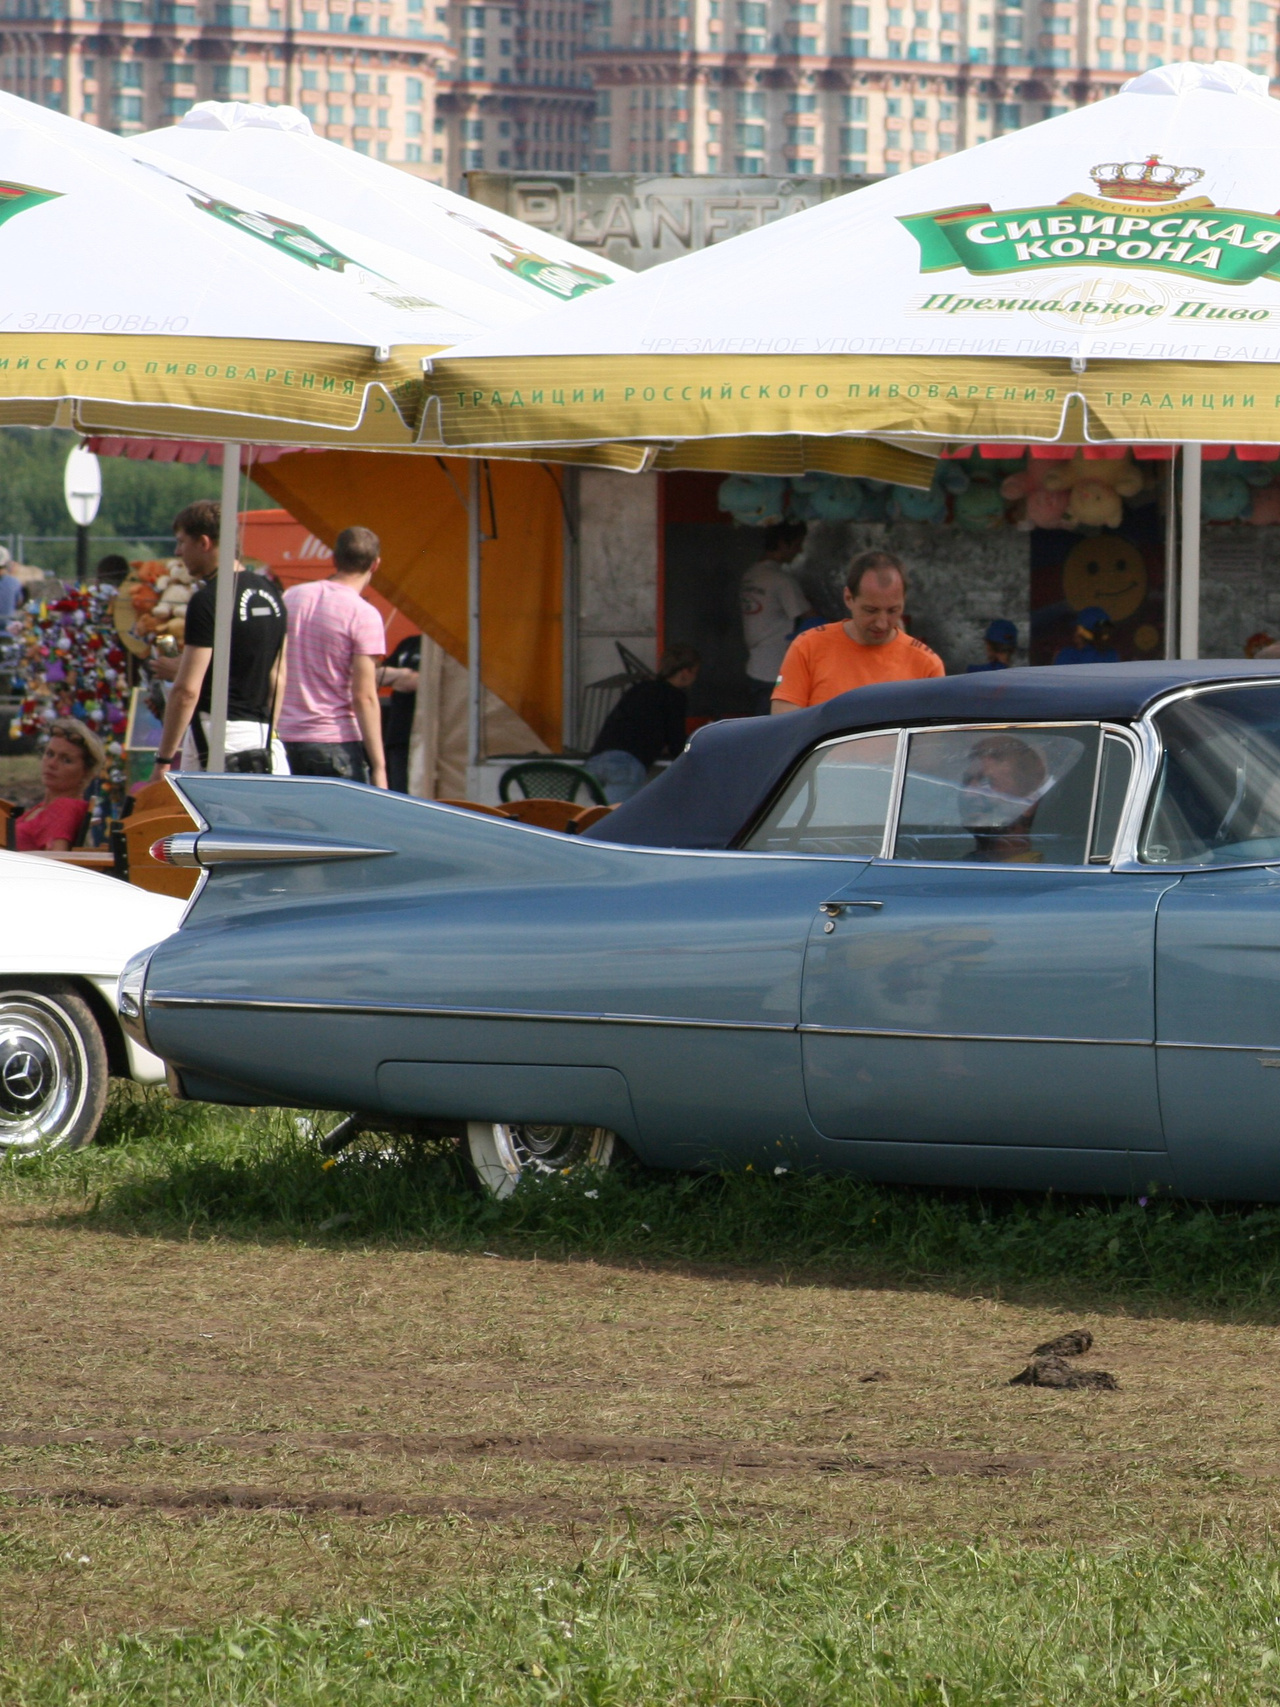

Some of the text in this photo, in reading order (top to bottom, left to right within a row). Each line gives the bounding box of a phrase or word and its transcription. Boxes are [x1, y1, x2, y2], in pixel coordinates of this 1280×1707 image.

[512, 183, 820, 249] PLANET
[1016, 236, 1224, 269] КОРОНА
[917, 293, 1272, 322] Премиальное Пиво
[18, 313, 189, 332] ЗДОРОВЬЮ
[641, 338, 807, 353] ЧРЕЗМЕРНОЕ
[814, 337, 1006, 354] УПОТРЕБЛЕНИЕ
[1015, 338, 1081, 354] ПИВА
[1089, 340, 1208, 359] ВРЕДИТ
[145, 361, 354, 395] ПИВОВАРЕНИЯ
[456, 383, 1057, 408] ТРАДИЦИИ РОССИЙСКОГО ПИВОВАРЕНИЯ
[1104, 391, 1256, 410] ТРАДИЦИИ
